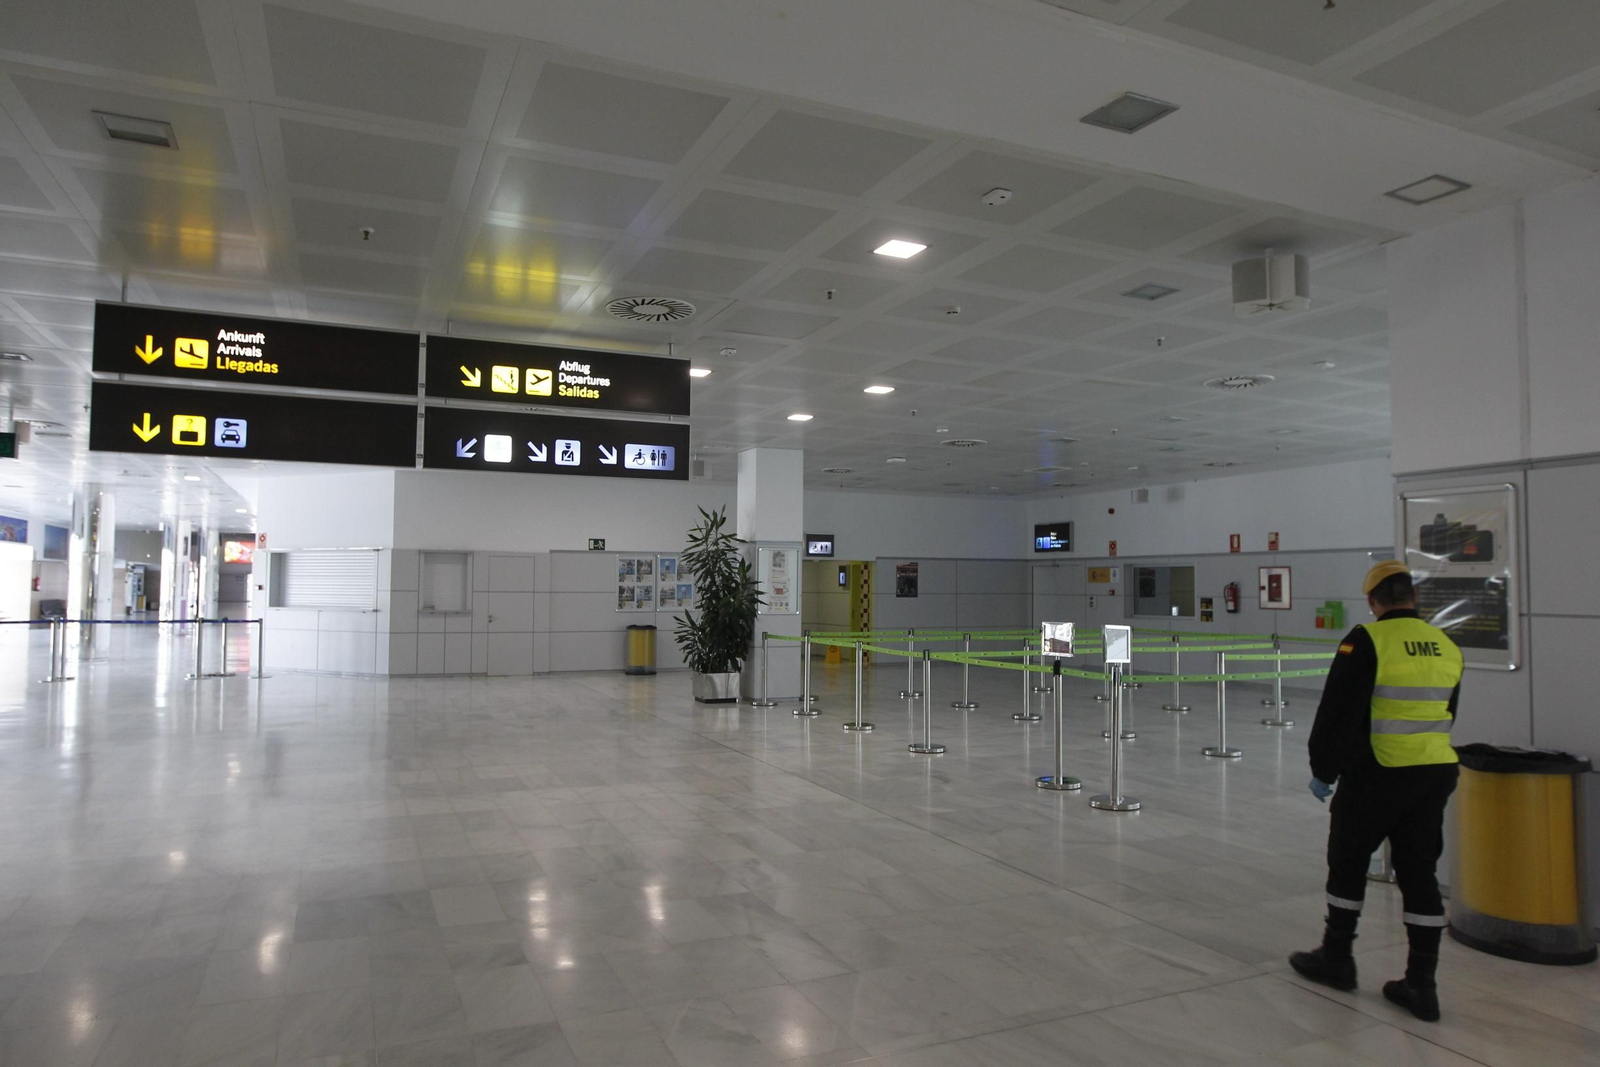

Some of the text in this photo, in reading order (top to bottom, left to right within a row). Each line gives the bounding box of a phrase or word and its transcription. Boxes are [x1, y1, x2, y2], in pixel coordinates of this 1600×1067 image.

[217, 329, 265, 344] Ankunft
[217, 343, 262, 357] Arrivals
[216, 356, 279, 373] Llegadas
[559, 360, 590, 375] Abflug
[558, 372, 610, 386] Departures
[558, 385, 600, 398] Salidas
[1403, 641, 1442, 657] UME
